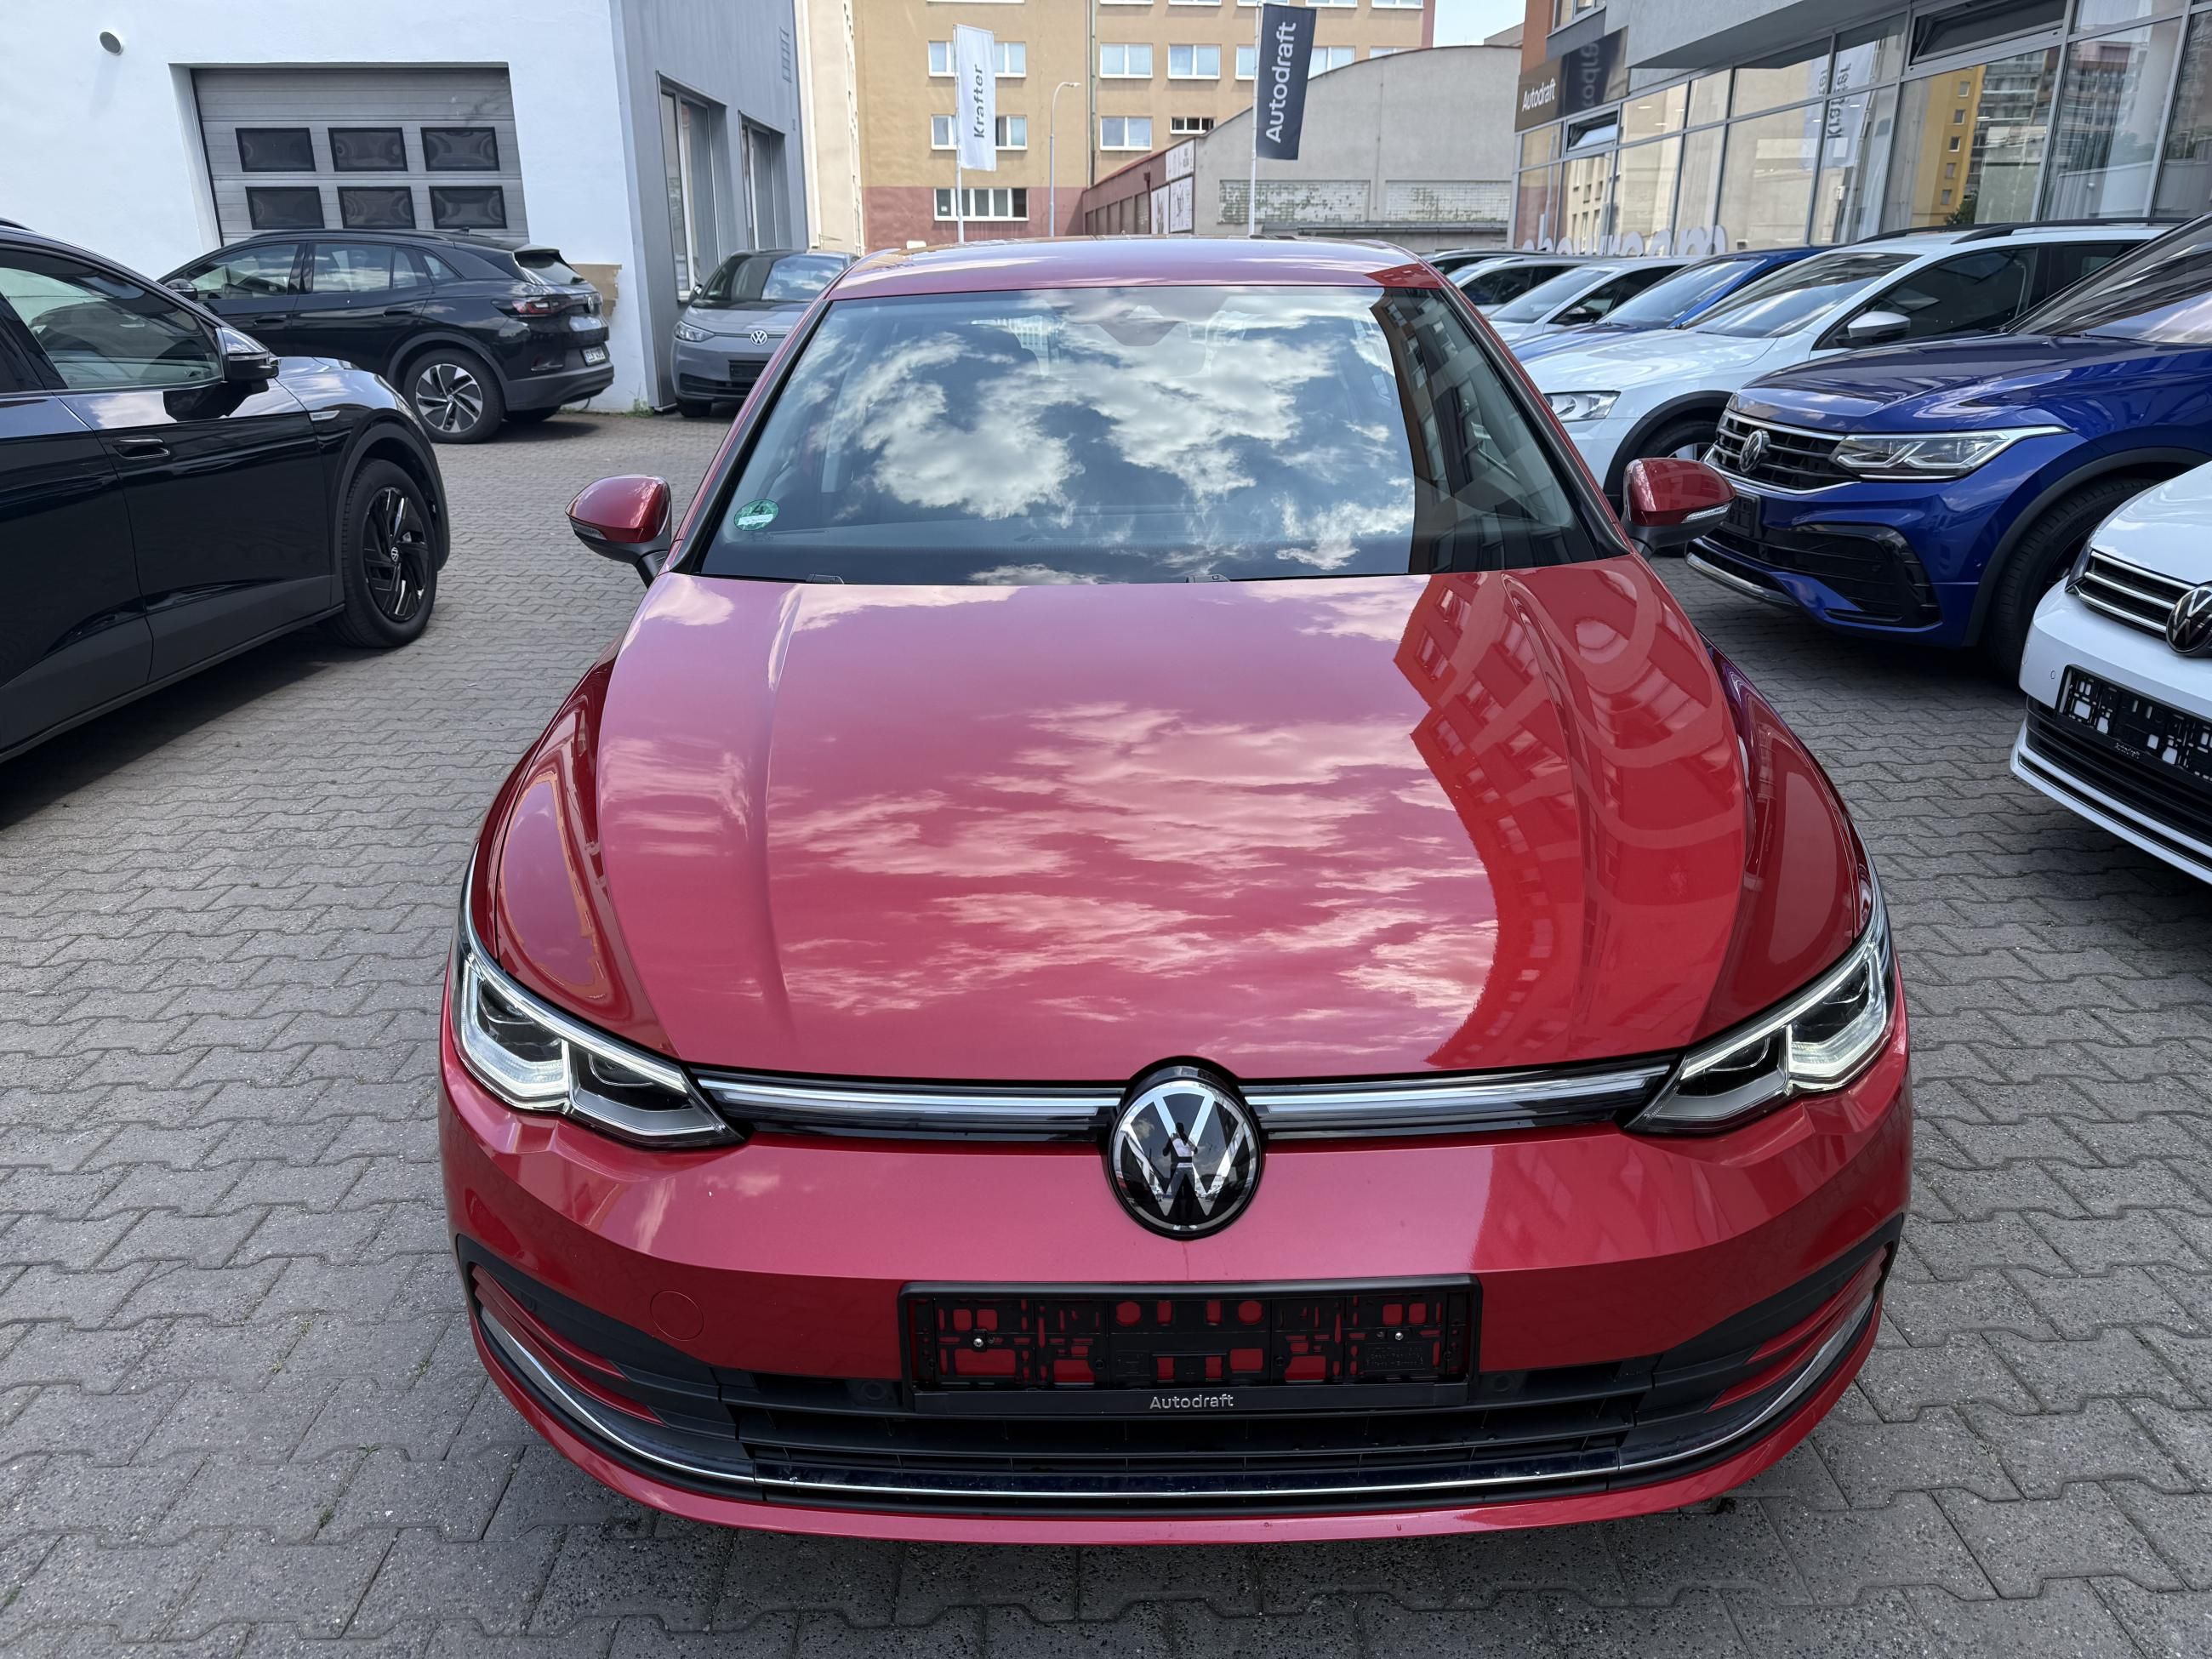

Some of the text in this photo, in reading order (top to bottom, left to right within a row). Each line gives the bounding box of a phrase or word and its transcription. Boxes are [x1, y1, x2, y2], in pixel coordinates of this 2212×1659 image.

[973, 64, 984, 138] Krafter
[1266, 22, 1296, 143] Autodraft
[1522, 77, 1556, 111] Autodraft
[1114, 1080, 1257, 1231] VW
[1149, 1394, 1234, 1409] Autodraft
